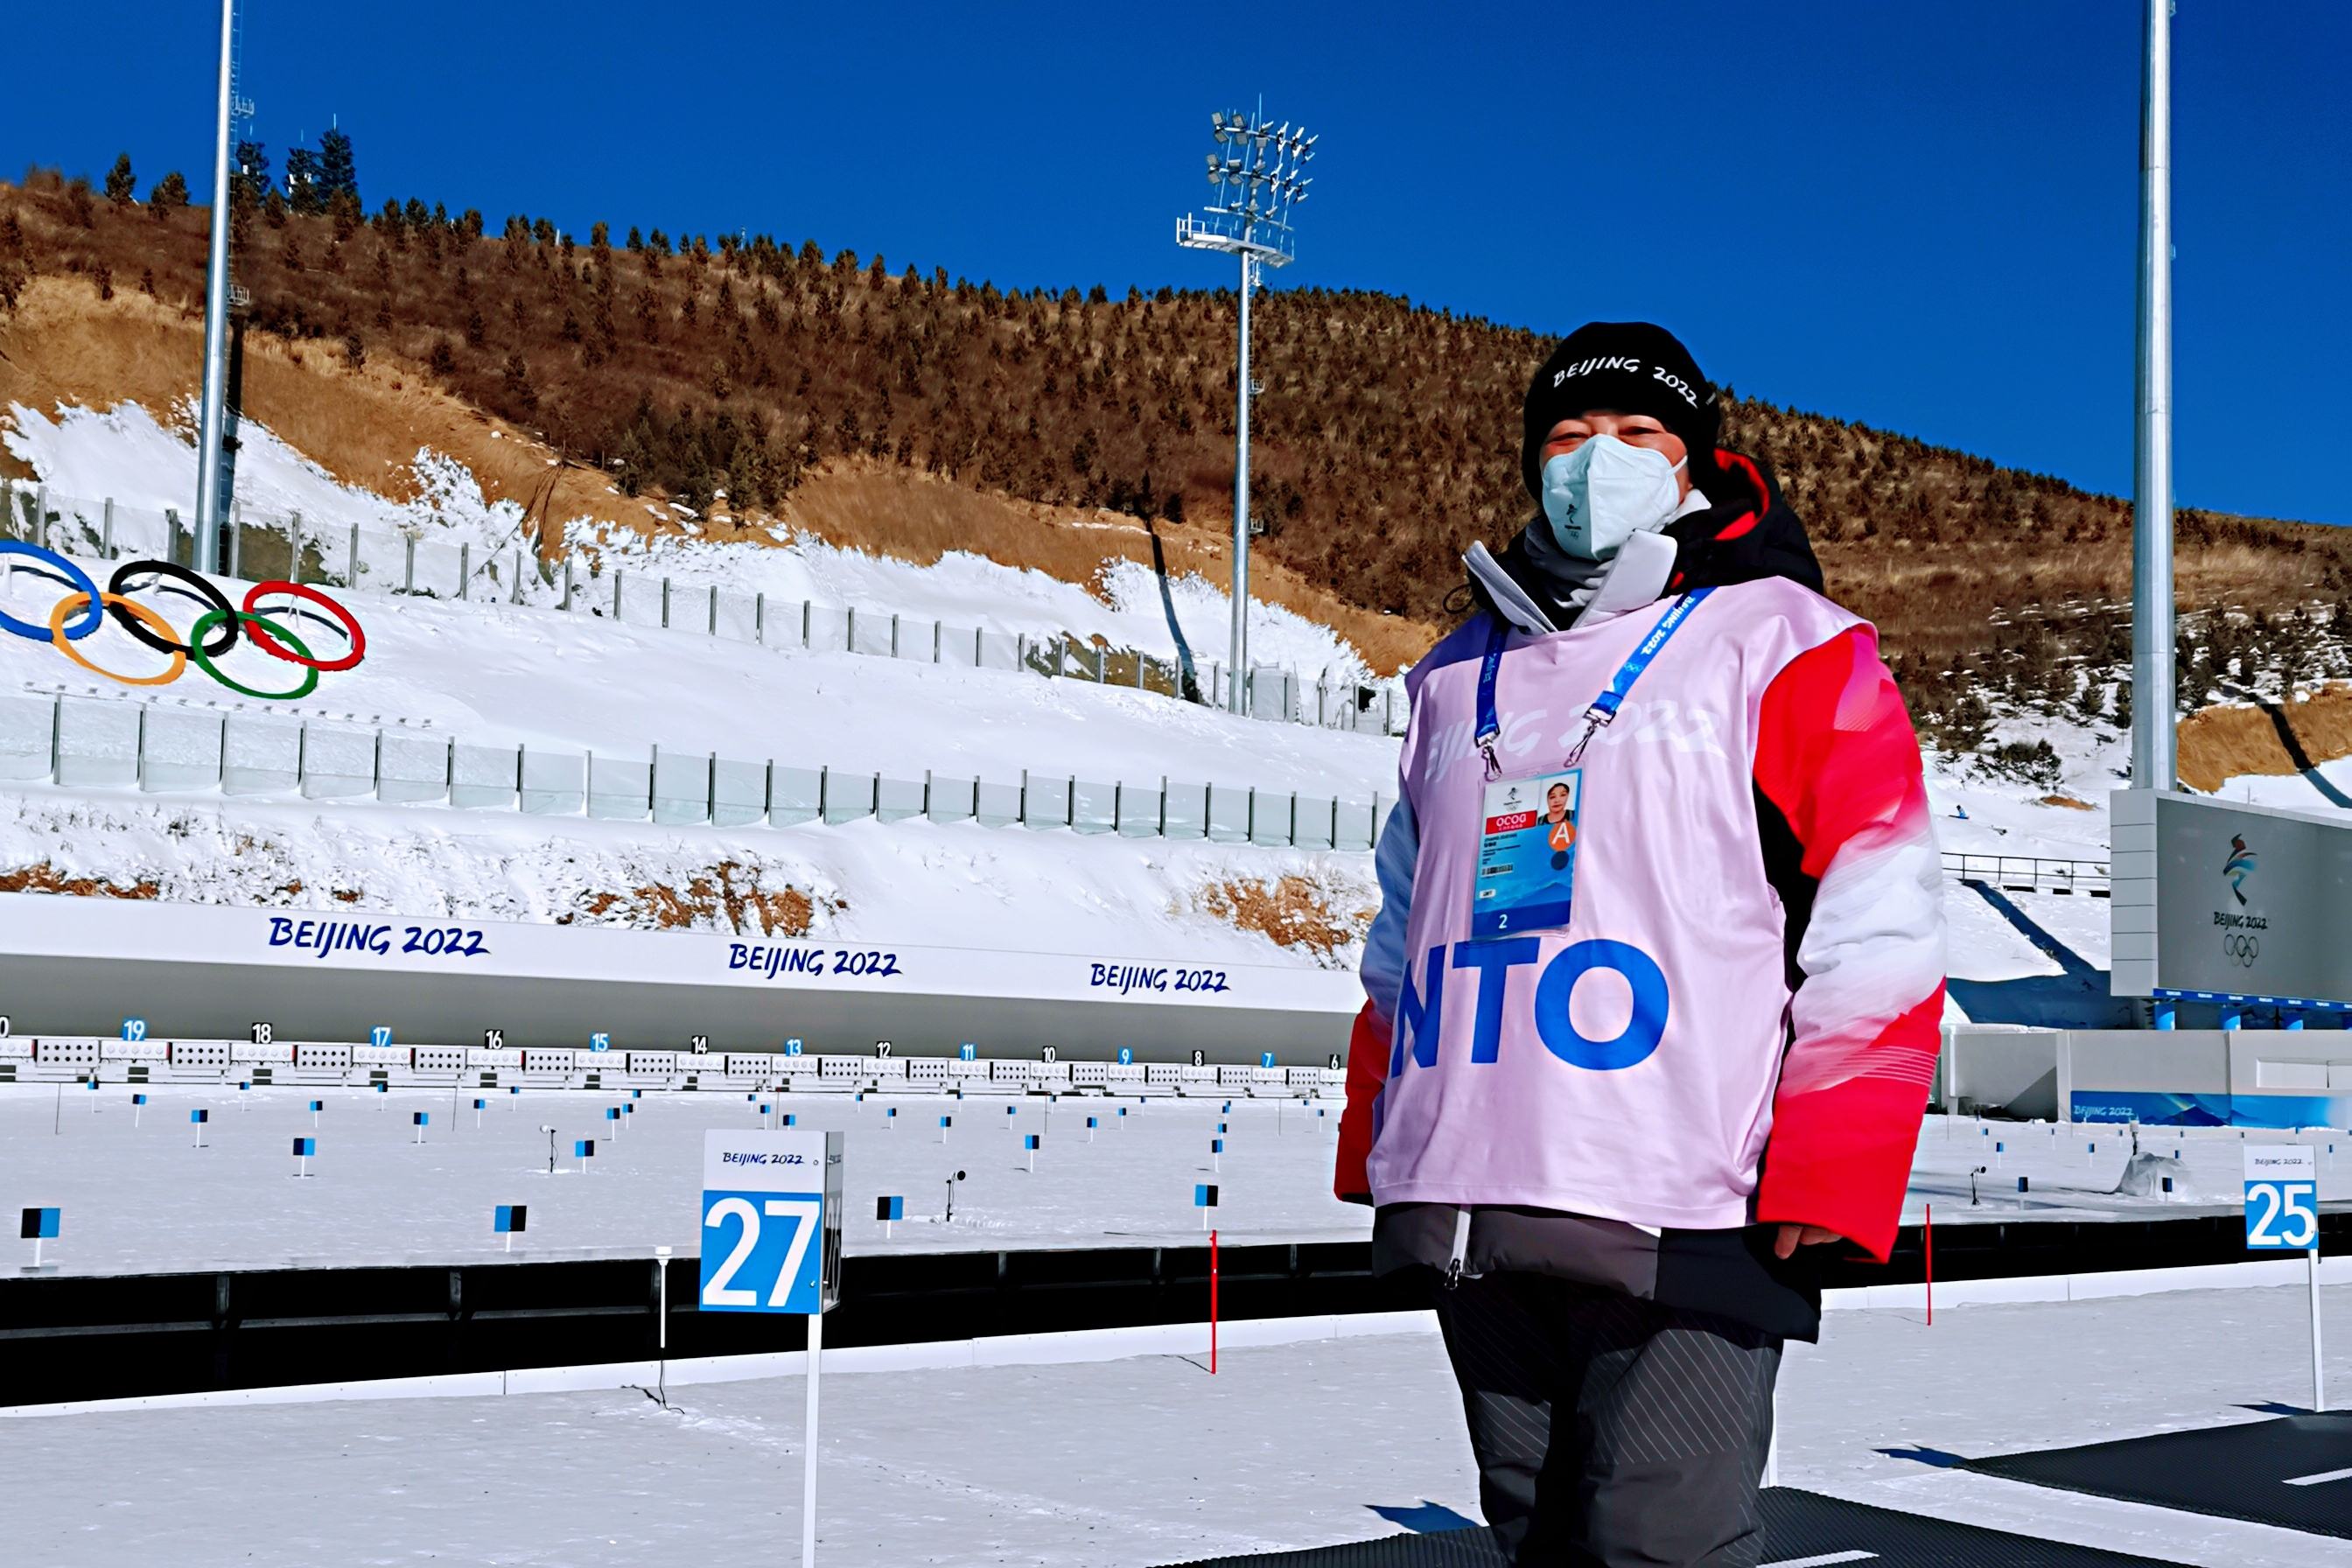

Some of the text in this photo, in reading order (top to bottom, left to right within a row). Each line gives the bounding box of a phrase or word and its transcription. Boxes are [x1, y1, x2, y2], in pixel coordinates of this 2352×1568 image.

[1553, 357, 1698, 409] BEIJING 2022
[1551, 822, 1571, 845] A
[1498, 914, 1508, 929] 2
[2213, 911, 2268, 930] BEIJING 2022
[269, 917, 492, 958] BEIJING 2022
[729, 943, 903, 980] BEIJING 2022
[1090, 962, 1231, 995] BEIJING 2022
[1390, 937, 1670, 1079] NTO
[0, 1016, 10, 1038] 0
[123, 1019, 145, 1040] 19
[252, 1023, 272, 1043] 18
[373, 1026, 391, 1046] 17
[486, 1030, 503, 1049] 16
[592, 1033, 608, 1051] 15
[692, 1036, 708, 1054] 14
[787, 1039, 802, 1056] 13
[877, 1041, 891, 1058] 12
[962, 1043, 974, 1060] 11
[1043, 1046, 1055, 1062] 10
[1121, 1048, 1130, 1064] 9
[1194, 1051, 1202, 1067] 8
[1264, 1053, 1272, 1068] 7
[1331, 1054, 1339, 1069] 6
[2073, 1105, 2134, 1117] BEIJING 2022
[723, 1152, 805, 1166] BEIJING 2022
[2246, 1183, 2316, 1247] 25
[703, 1197, 821, 1307] 27
